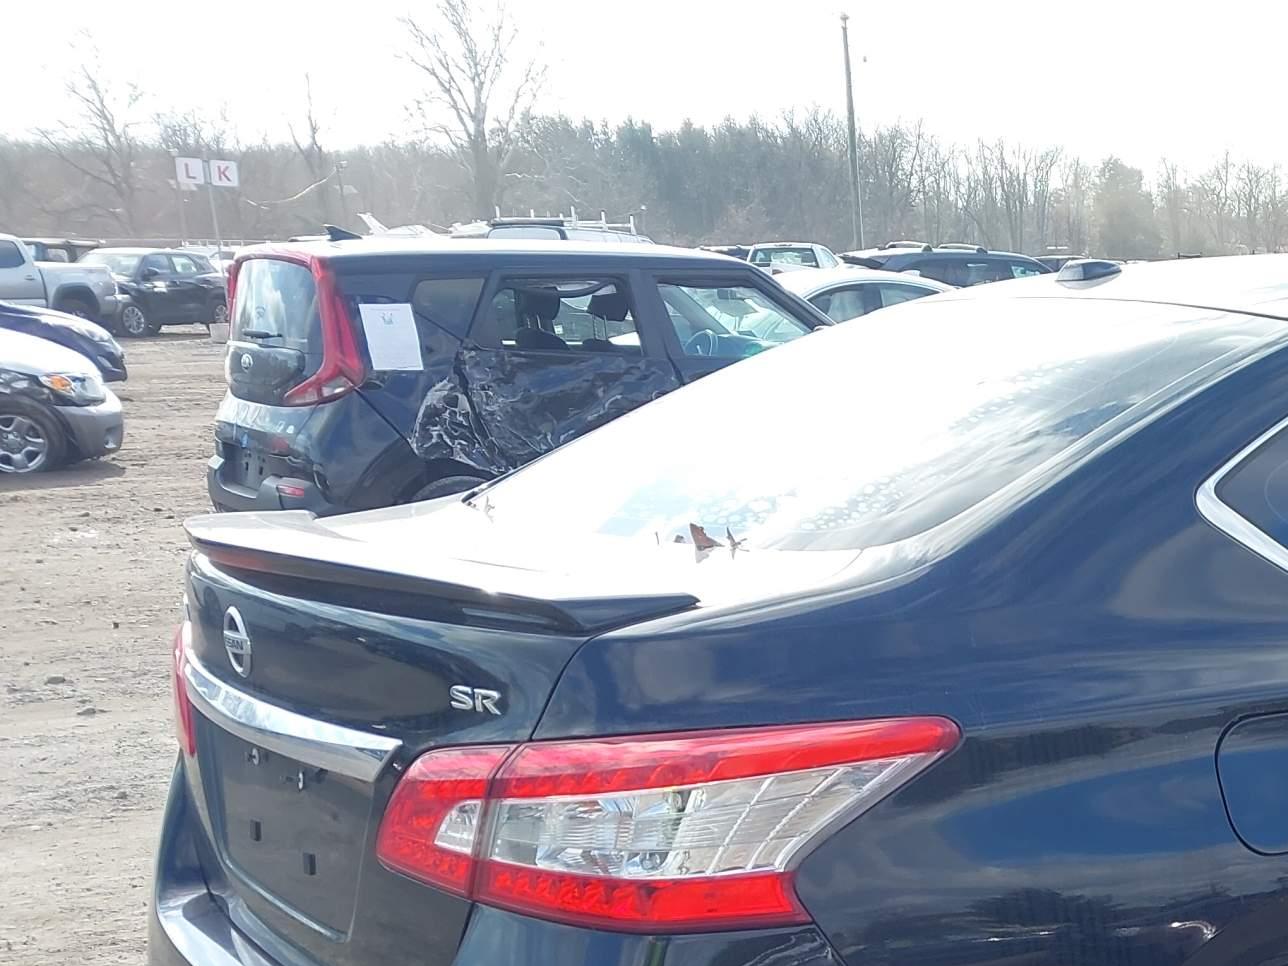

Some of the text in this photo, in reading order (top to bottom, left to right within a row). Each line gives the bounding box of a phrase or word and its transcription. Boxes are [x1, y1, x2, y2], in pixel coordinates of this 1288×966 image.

[184, 163, 197, 180] L
[217, 165, 232, 182] K
[449, 685, 502, 716] SR
